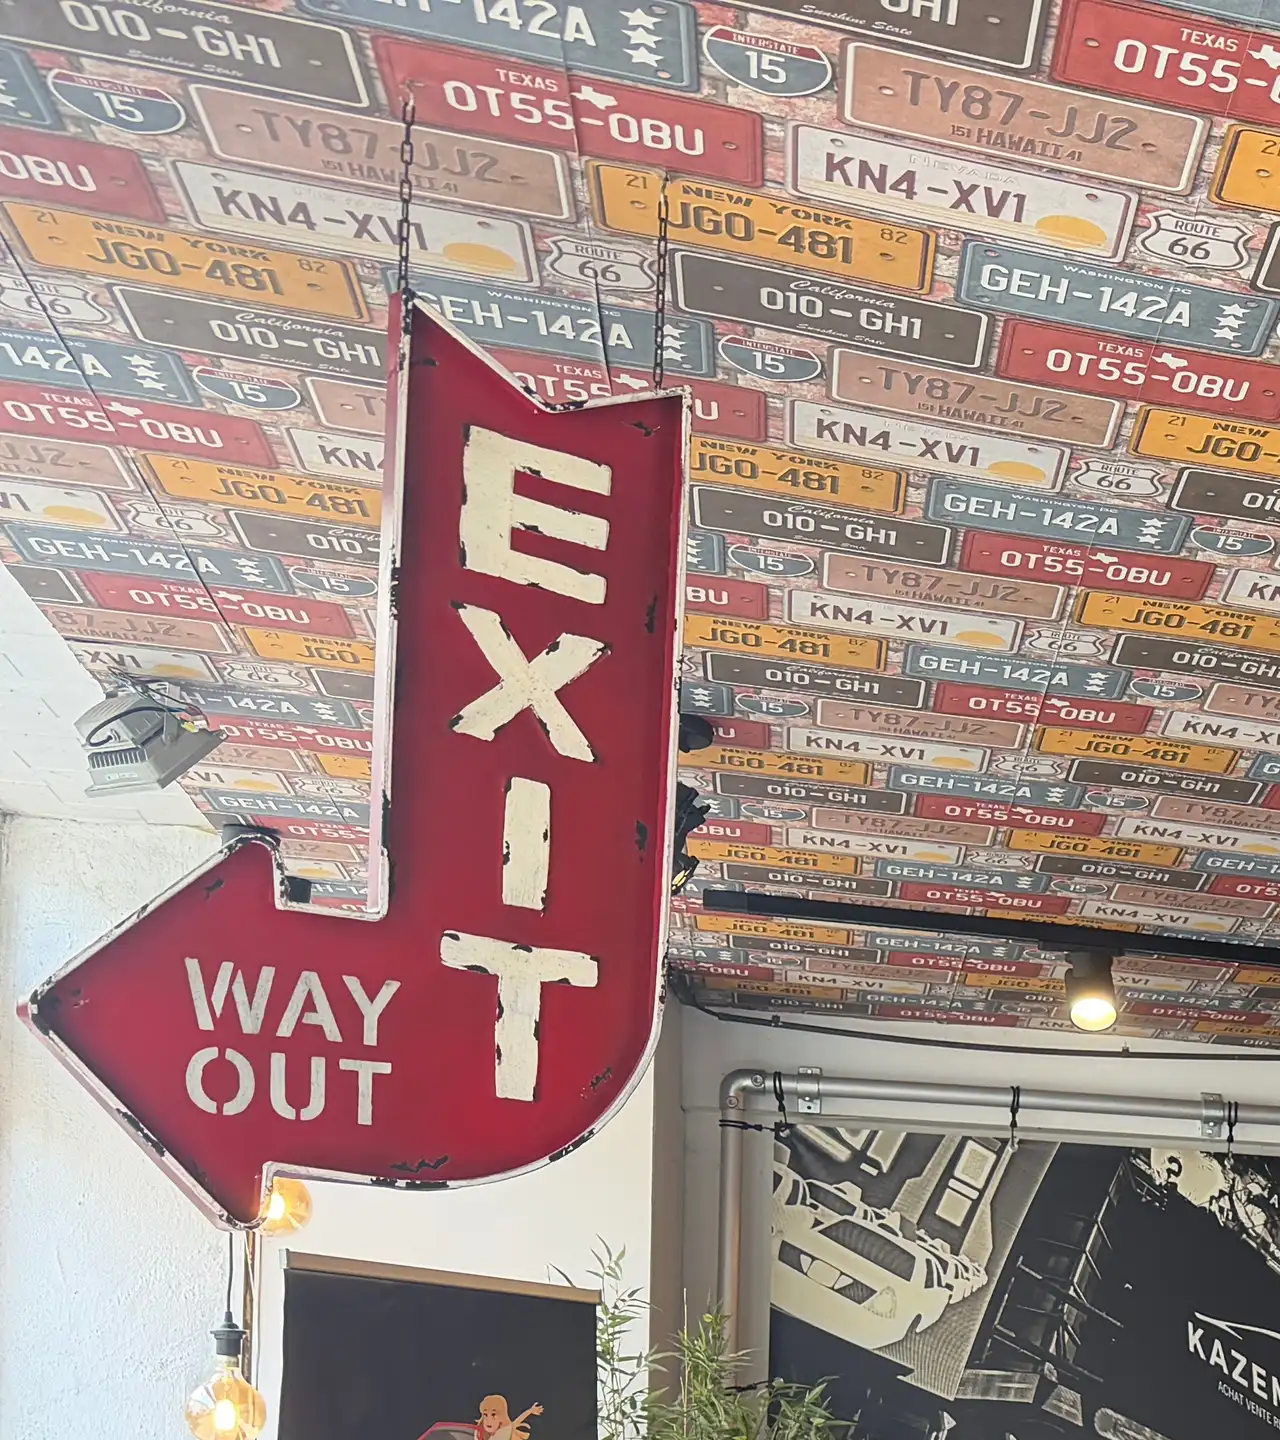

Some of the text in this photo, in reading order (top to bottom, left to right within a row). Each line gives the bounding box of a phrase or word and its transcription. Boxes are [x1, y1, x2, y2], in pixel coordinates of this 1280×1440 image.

[731, 32, 799, 54] INTERSTATE
[1180, 25, 1238, 51] TEXAS
[495, 67, 559, 92] TEXAS
[745, 50, 786, 83] 15
[902, 69, 1137, 152] TY87-JJ2
[950, 124, 1083, 162] 151 HAWAII 41
[1174, 220, 1223, 238] ROUTE
[574, 244, 623, 262] ROUTE
[1168, 236, 1210, 260] 66
[577, 260, 621, 283] 66
[1063, 264, 1192, 295] WASHINGTON DC
[980, 264, 1189, 329] GEH-142A
[228, 381, 268, 402] 15
[26, 534, 222, 576] GEH-142A
[440, 424, 612, 1101] EXIT
[183, 956, 401, 1047] WAY
[185, 1046, 392, 1126] OUT
[1218, 1381, 1244, 1406] ACHAT
[1245, 1397, 1272, 1424] VENTE
